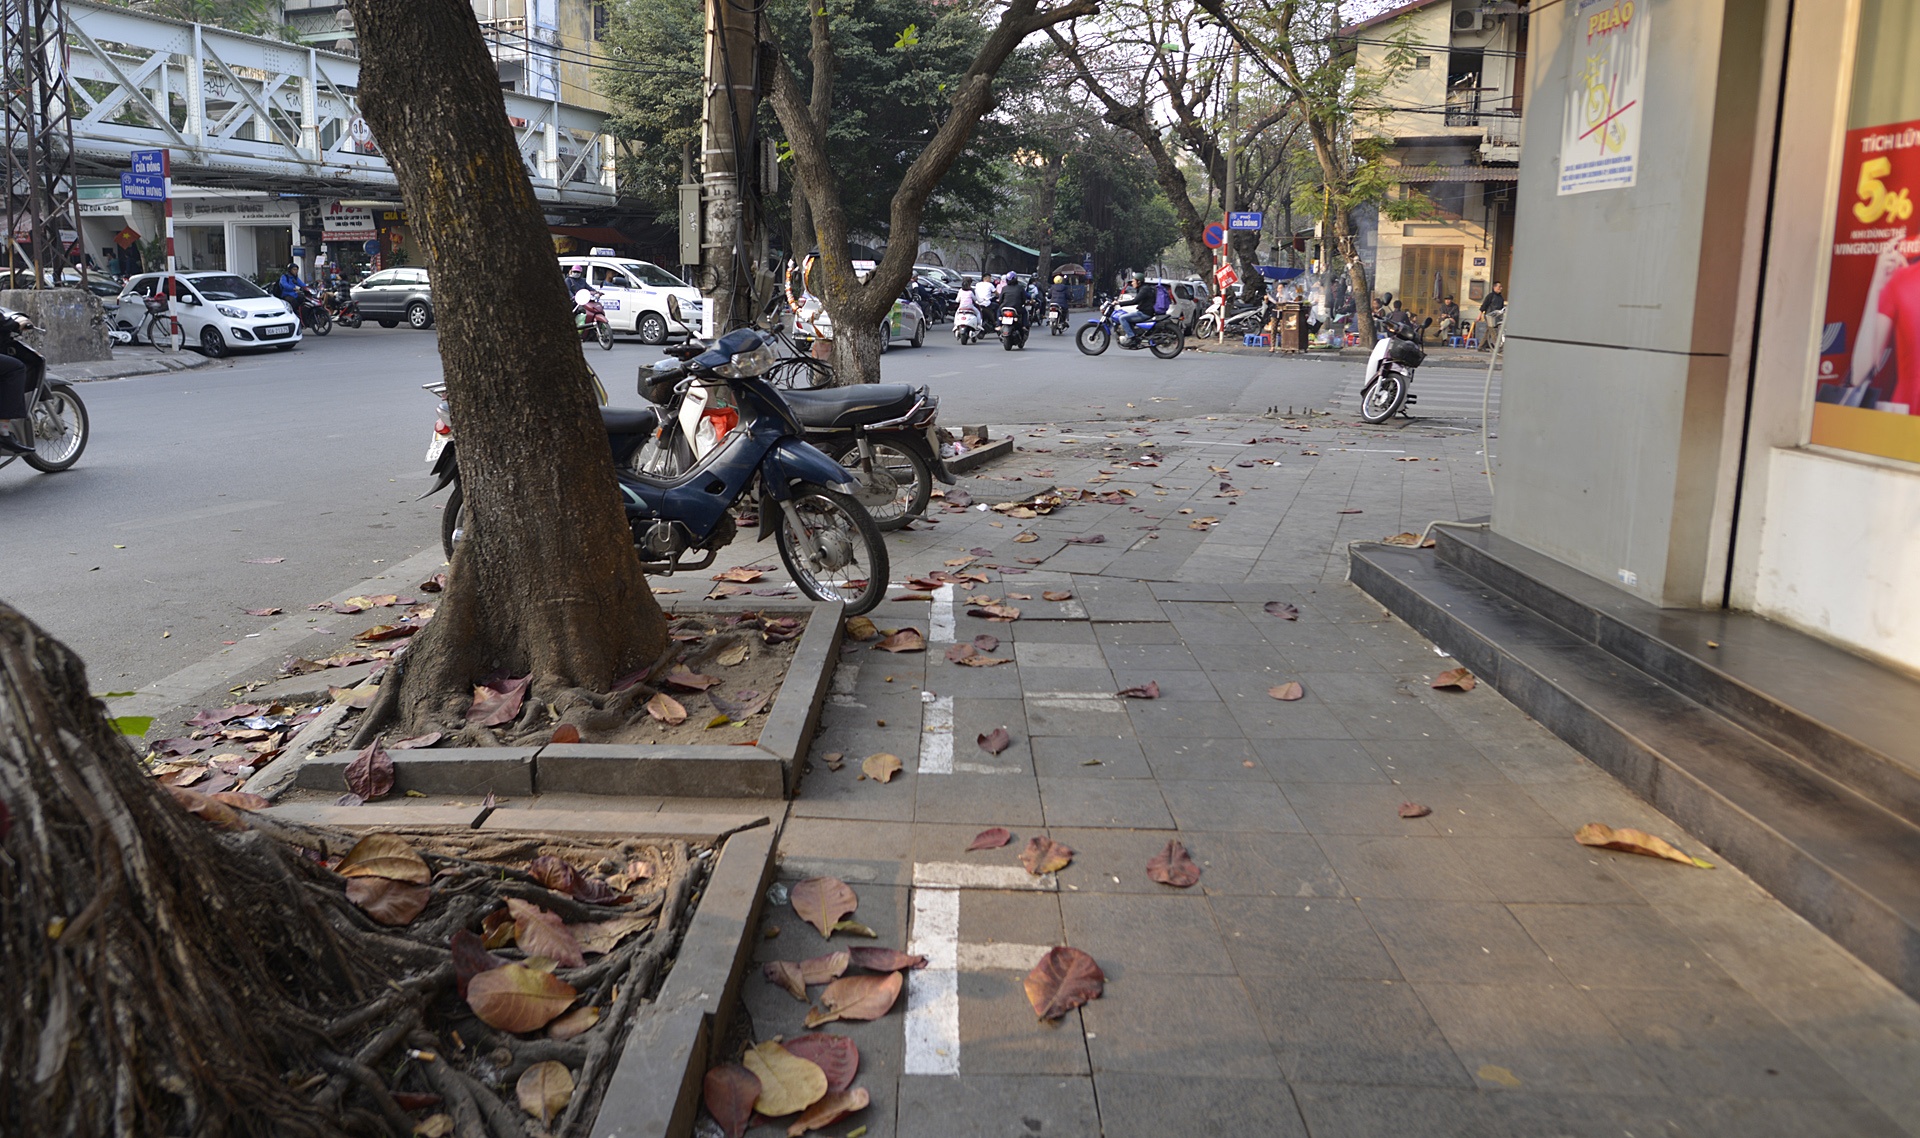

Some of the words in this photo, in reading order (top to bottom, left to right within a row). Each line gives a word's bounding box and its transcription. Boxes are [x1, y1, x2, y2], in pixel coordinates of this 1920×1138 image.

[1588, 0, 1635, 36] PHÁO
[1861, 134, 1894, 153] TÍCH
[124, 184, 145, 196] PHÙNG
[1852, 156, 1914, 224] 5%
